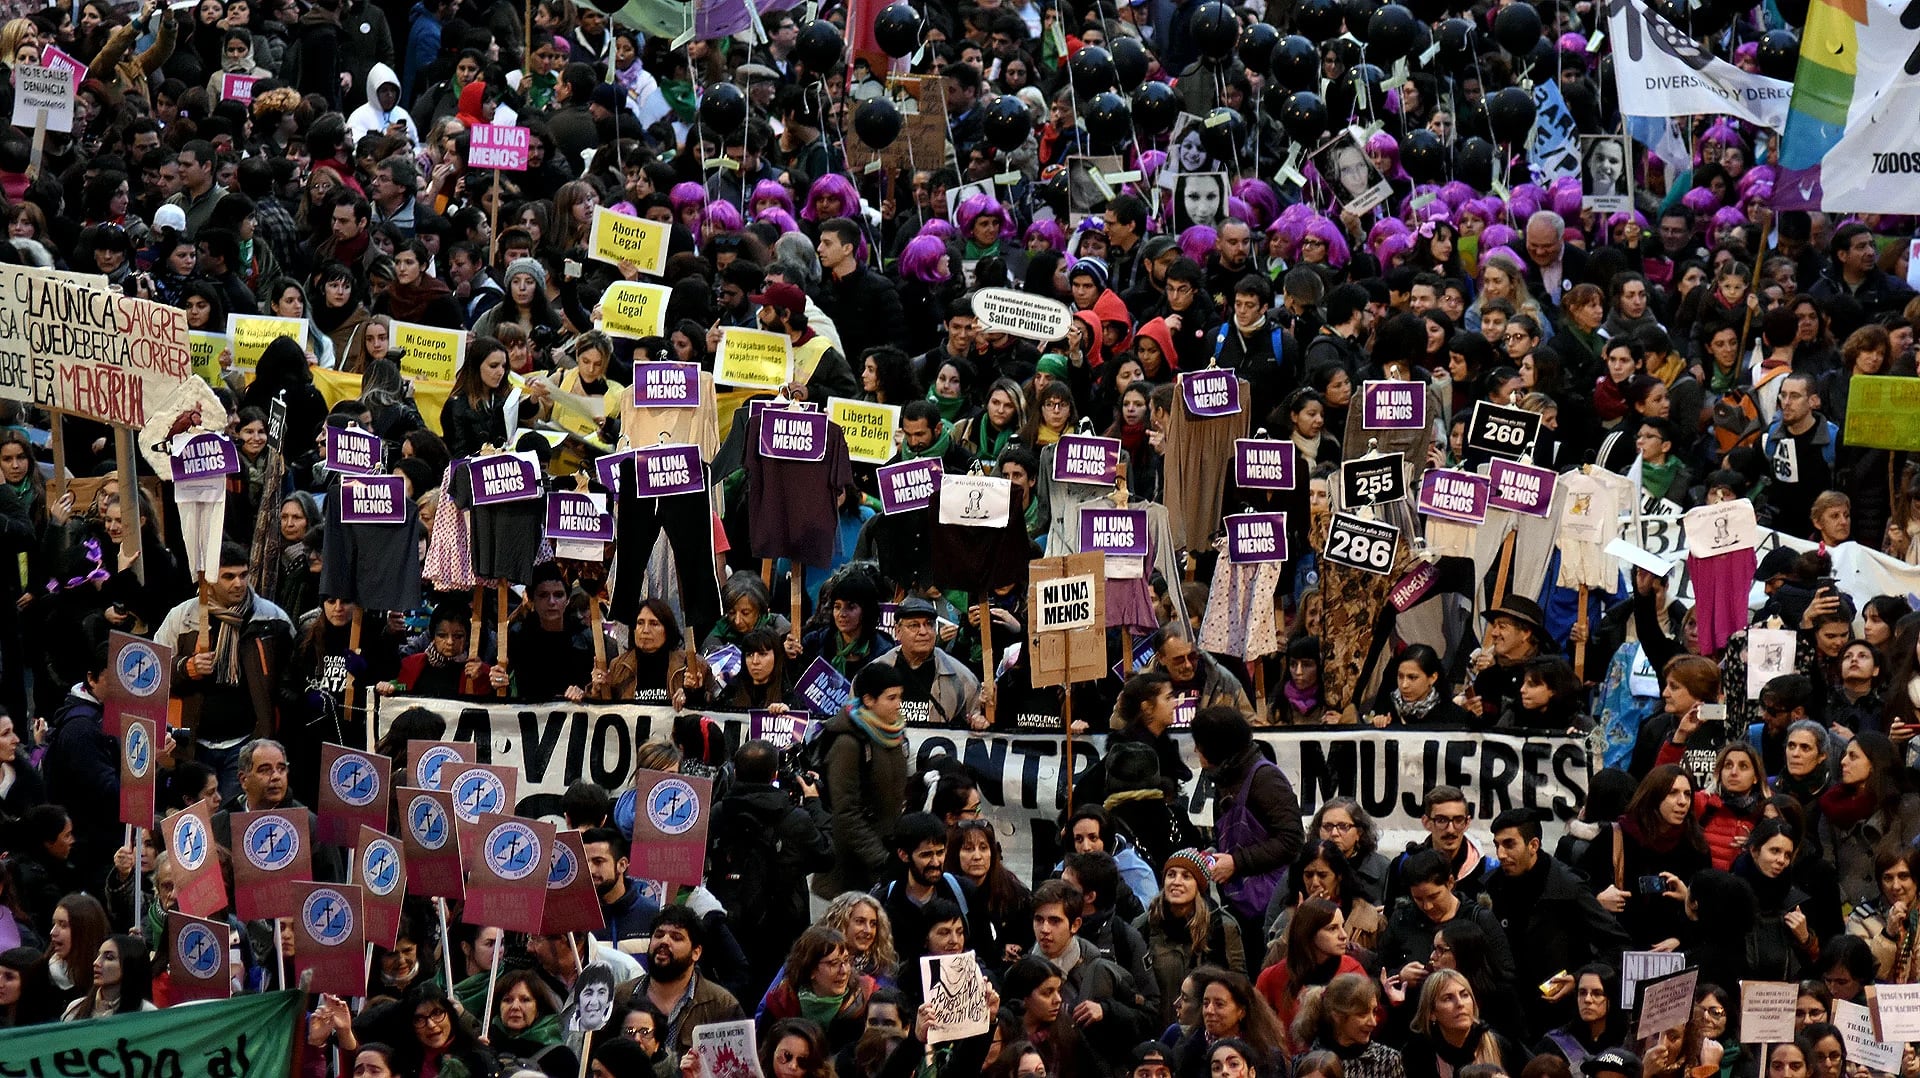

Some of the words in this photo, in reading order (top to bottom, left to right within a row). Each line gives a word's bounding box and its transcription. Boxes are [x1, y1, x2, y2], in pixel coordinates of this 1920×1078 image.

[20, 67, 31, 77] NO
[33, 68, 41, 78] TE
[23, 81, 66, 95] DENUNCIA
[473, 126, 489, 144] NI
[493, 128, 526, 148] UNA
[468, 147, 520, 169] MENOS
[612, 222, 646, 240] Aborto
[613, 233, 642, 250] Legal
[617, 290, 648, 305] Aborto
[617, 303, 643, 318] Legal
[984, 301, 997, 311] un
[999, 304, 1047, 322] problema
[1049, 314, 1061, 324] de
[117, 296, 185, 346] SANGRE
[989, 312, 1017, 328] Salud
[1019, 318, 1055, 335] Pública
[405, 334, 415, 344] Mi
[416, 337, 447, 350] Cuerpo
[726, 339, 735, 348] No
[736, 340, 767, 351] viajaban
[130, 338, 190, 384] CORRER
[413, 349, 452, 362] Derechos
[729, 351, 759, 363] viajaban
[33, 358, 55, 382] ES
[647, 370, 660, 384] NI
[662, 370, 686, 384] UNA
[34, 379, 56, 406] LA
[646, 385, 687, 399] MENOS
[1193, 379, 1206, 394] NI
[1207, 376, 1228, 392] UNA
[1194, 392, 1229, 409] MENOS
[1376, 391, 1389, 405] NI
[1391, 391, 1413, 405] UNA
[842, 409, 884, 426] Libertad
[1375, 405, 1413, 420] MENOS
[774, 418, 787, 434] NI
[788, 419, 813, 436] UNA
[861, 425, 889, 441] Belén
[1483, 422, 1525, 445] 260
[182, 445, 196, 459] NI
[196, 440, 223, 457] UNA
[338, 434, 349, 449] NI
[350, 436, 371, 452] UNA
[772, 435, 813, 452] MENOS
[337, 449, 371, 468] MENOS
[1068, 444, 1081, 459] NI
[1082, 445, 1106, 461] UNA
[1246, 449, 1257, 464] NI
[1259, 449, 1281, 465] UNA
[184, 455, 226, 475] MENOS
[482, 465, 496, 481] NI
[496, 461, 523, 478] UNA
[648, 457, 661, 473] NI
[662, 454, 688, 471] UNA
[1066, 459, 1106, 475] MENOS
[1246, 464, 1283, 480] MENOS
[484, 475, 525, 496] MENOS
[649, 470, 690, 488] MENOS
[891, 473, 907, 489] NI
[905, 468, 932, 486] UNA
[1356, 473, 1394, 497] 255
[1434, 477, 1450, 493] NI
[1450, 480, 1475, 498] UNA
[1500, 469, 1515, 485] NI
[1515, 472, 1541, 492] UNA
[353, 485, 366, 499] NI
[367, 484, 391, 499] UNA
[893, 483, 935, 504] MENOS
[1499, 485, 1539, 506] MENOS
[353, 500, 393, 513] MENOS
[560, 500, 573, 515] NI
[1432, 493, 1474, 513] MENOS
[559, 516, 601, 532] MENOS
[1093, 516, 1107, 532] NI
[1108, 516, 1134, 532] UNA
[1237, 523, 1249, 539] NI
[1250, 521, 1274, 537] UNA
[1093, 532, 1135, 548] MENOS
[1238, 537, 1276, 554] MENOS
[1330, 530, 1391, 568] 286
[1043, 586, 1058, 604] NI
[1061, 581, 1088, 602] UNA
[1044, 601, 1089, 625] MENOS
[813, 672, 829, 690] NI
[761, 716, 773, 733] NI
[773, 716, 795, 733] UNA
[1017, 713, 1026, 722] LA
[1299, 739, 1588, 822] MUJERES
[1626, 955, 1644, 980] NI
